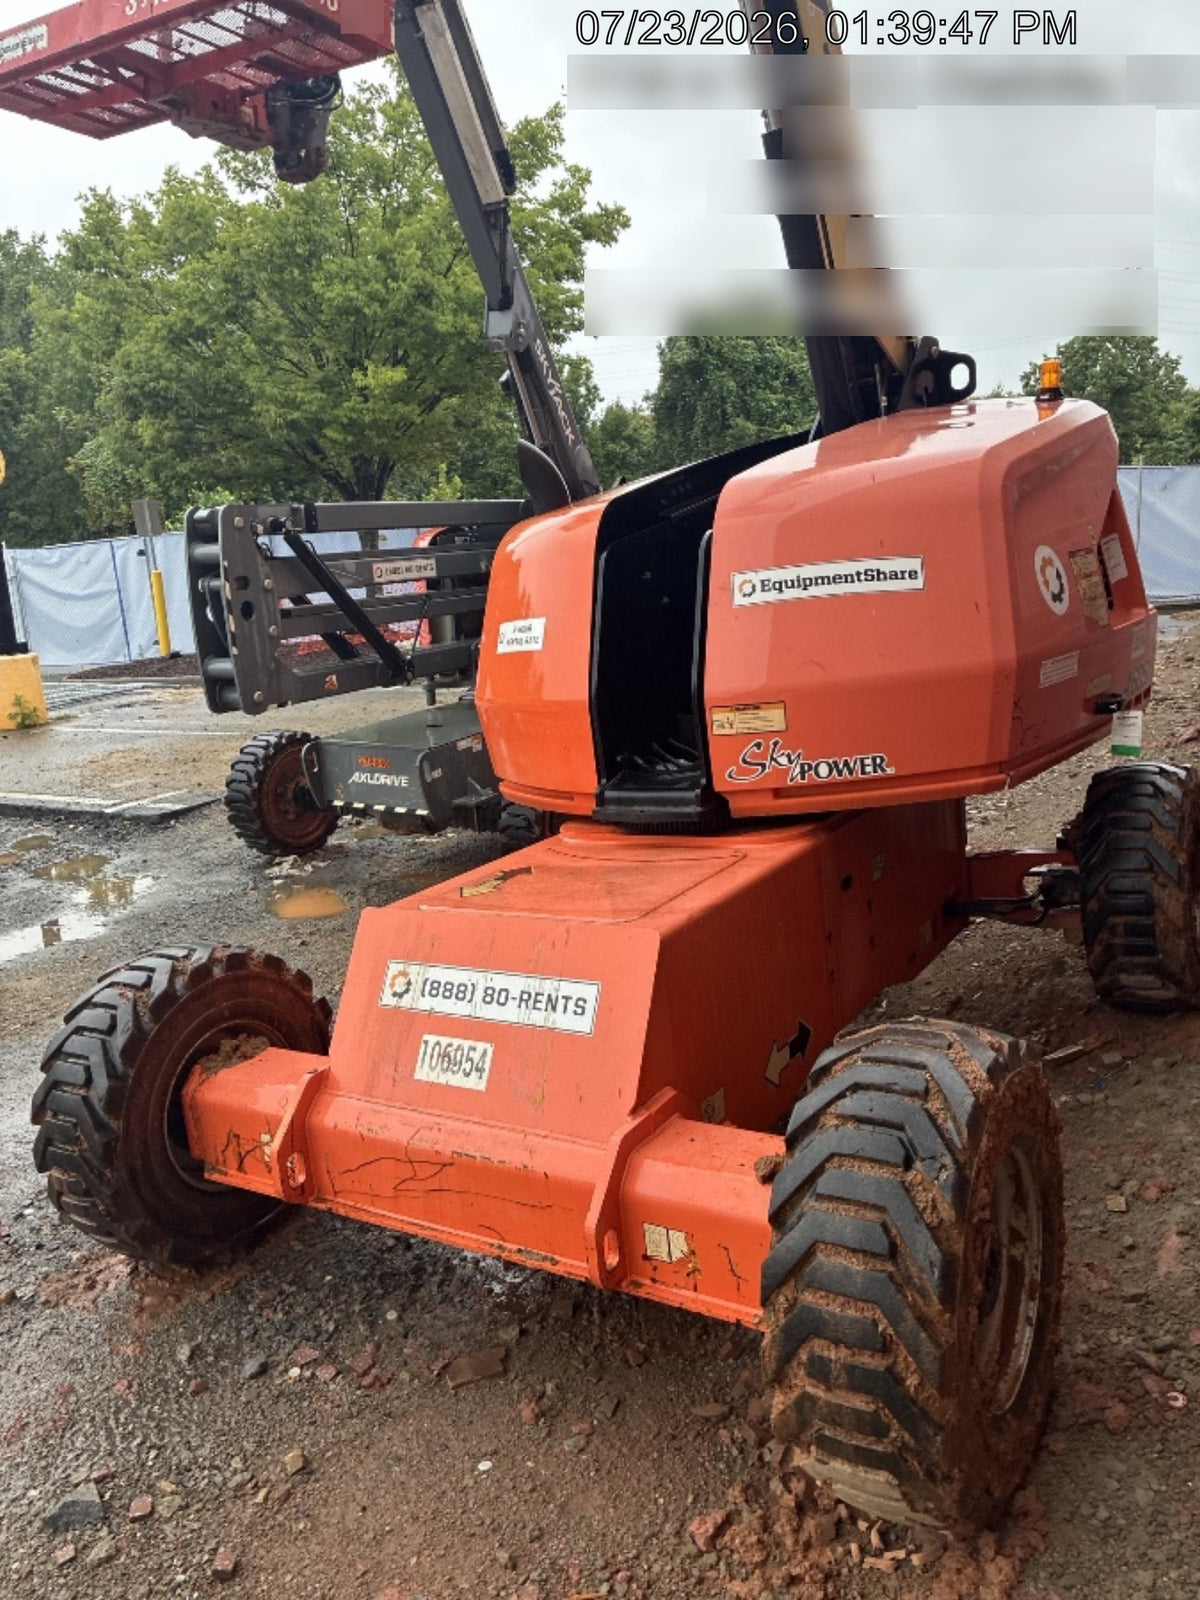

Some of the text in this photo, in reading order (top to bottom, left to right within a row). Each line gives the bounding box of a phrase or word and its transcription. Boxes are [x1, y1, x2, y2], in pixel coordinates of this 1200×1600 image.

[760, 567, 919, 594] EquipmentShare
[420, 976, 588, 1017] (888) 80-RENTS
